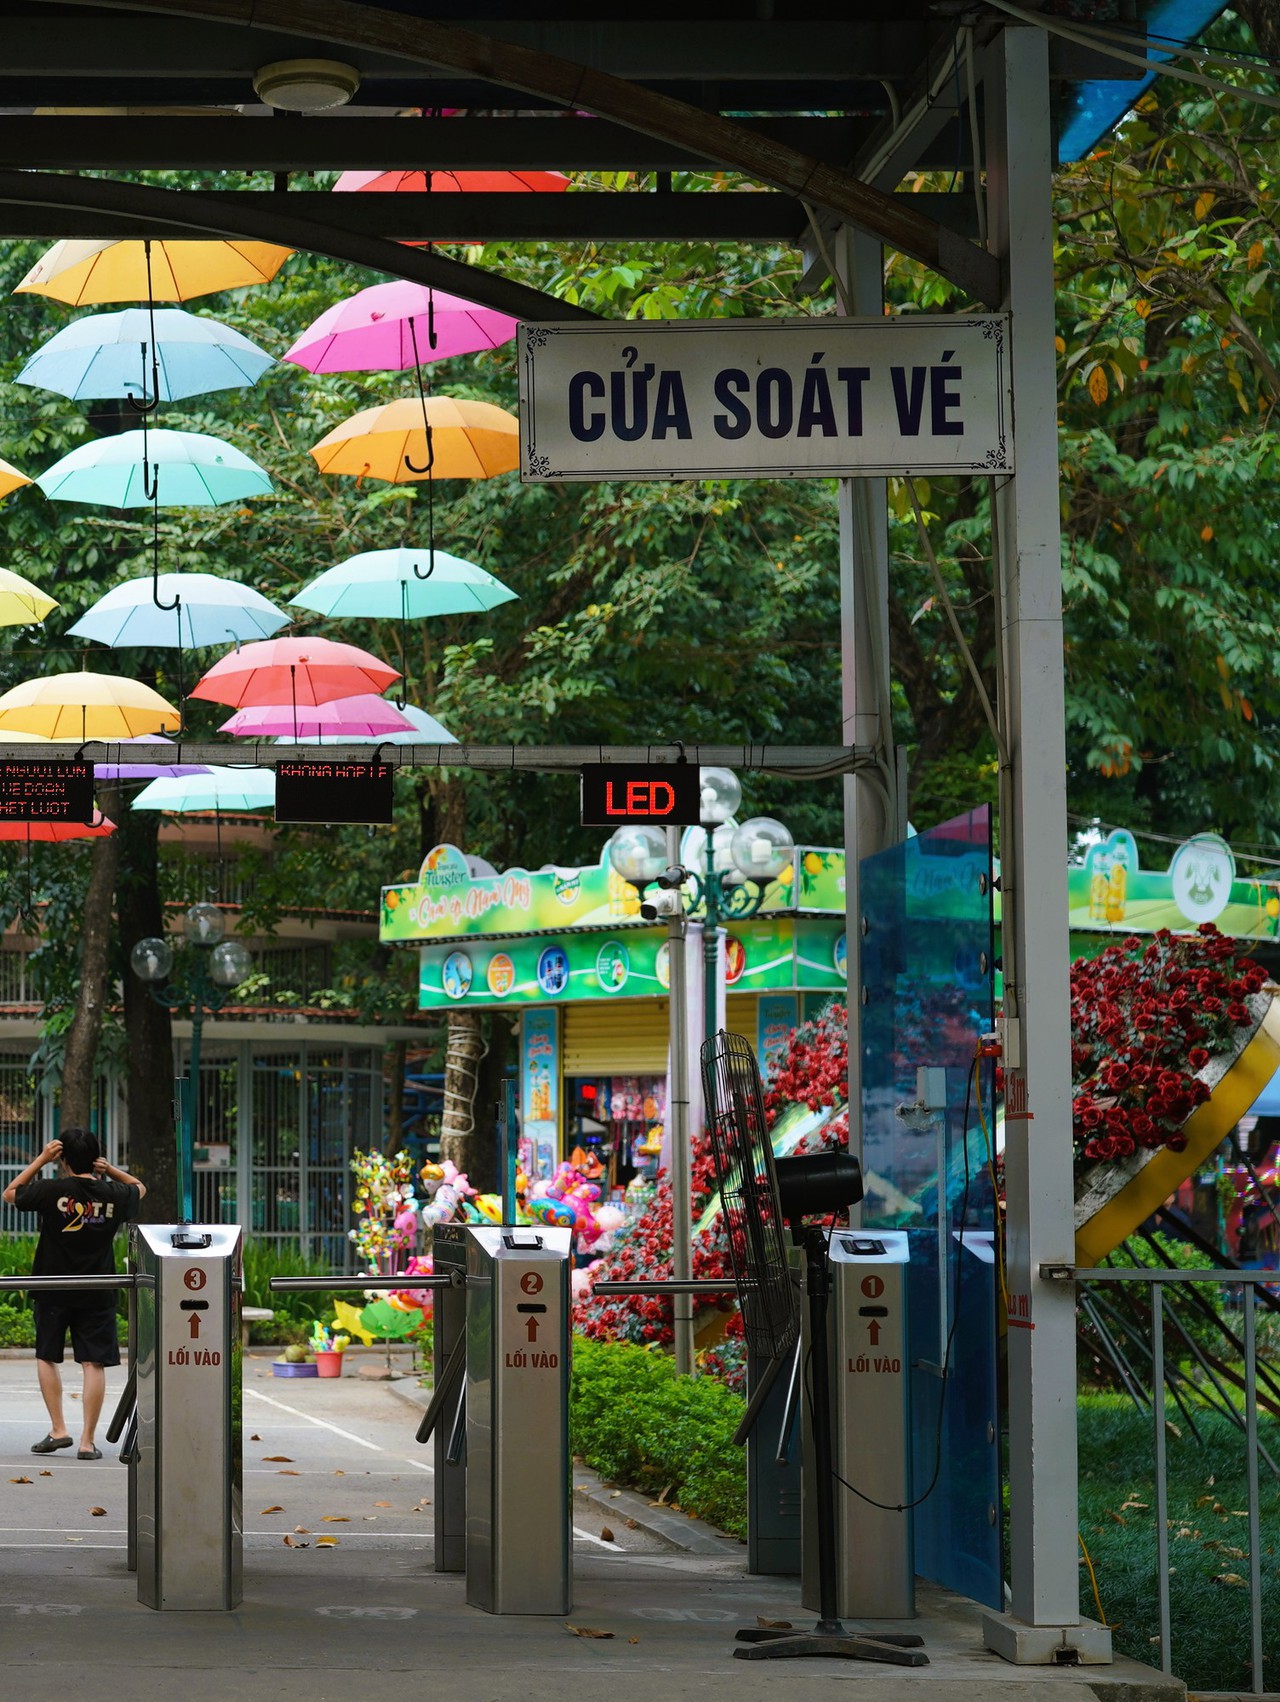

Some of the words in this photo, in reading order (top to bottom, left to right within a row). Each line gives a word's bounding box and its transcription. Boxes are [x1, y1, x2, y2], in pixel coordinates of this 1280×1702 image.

[568, 345, 693, 442] CỬA
[713, 351, 871, 440] SOÁT
[890, 350, 965, 437] VÉ
[606, 781, 675, 815] LED
[168, 1345, 189, 1365] LỐI
[194, 1348, 221, 1366] VÀO
[506, 1348, 527, 1368] LỐI
[531, 1350, 558, 1368] VÀO
[848, 1353, 869, 1373] LỐI
[874, 1355, 901, 1373] VÀO
